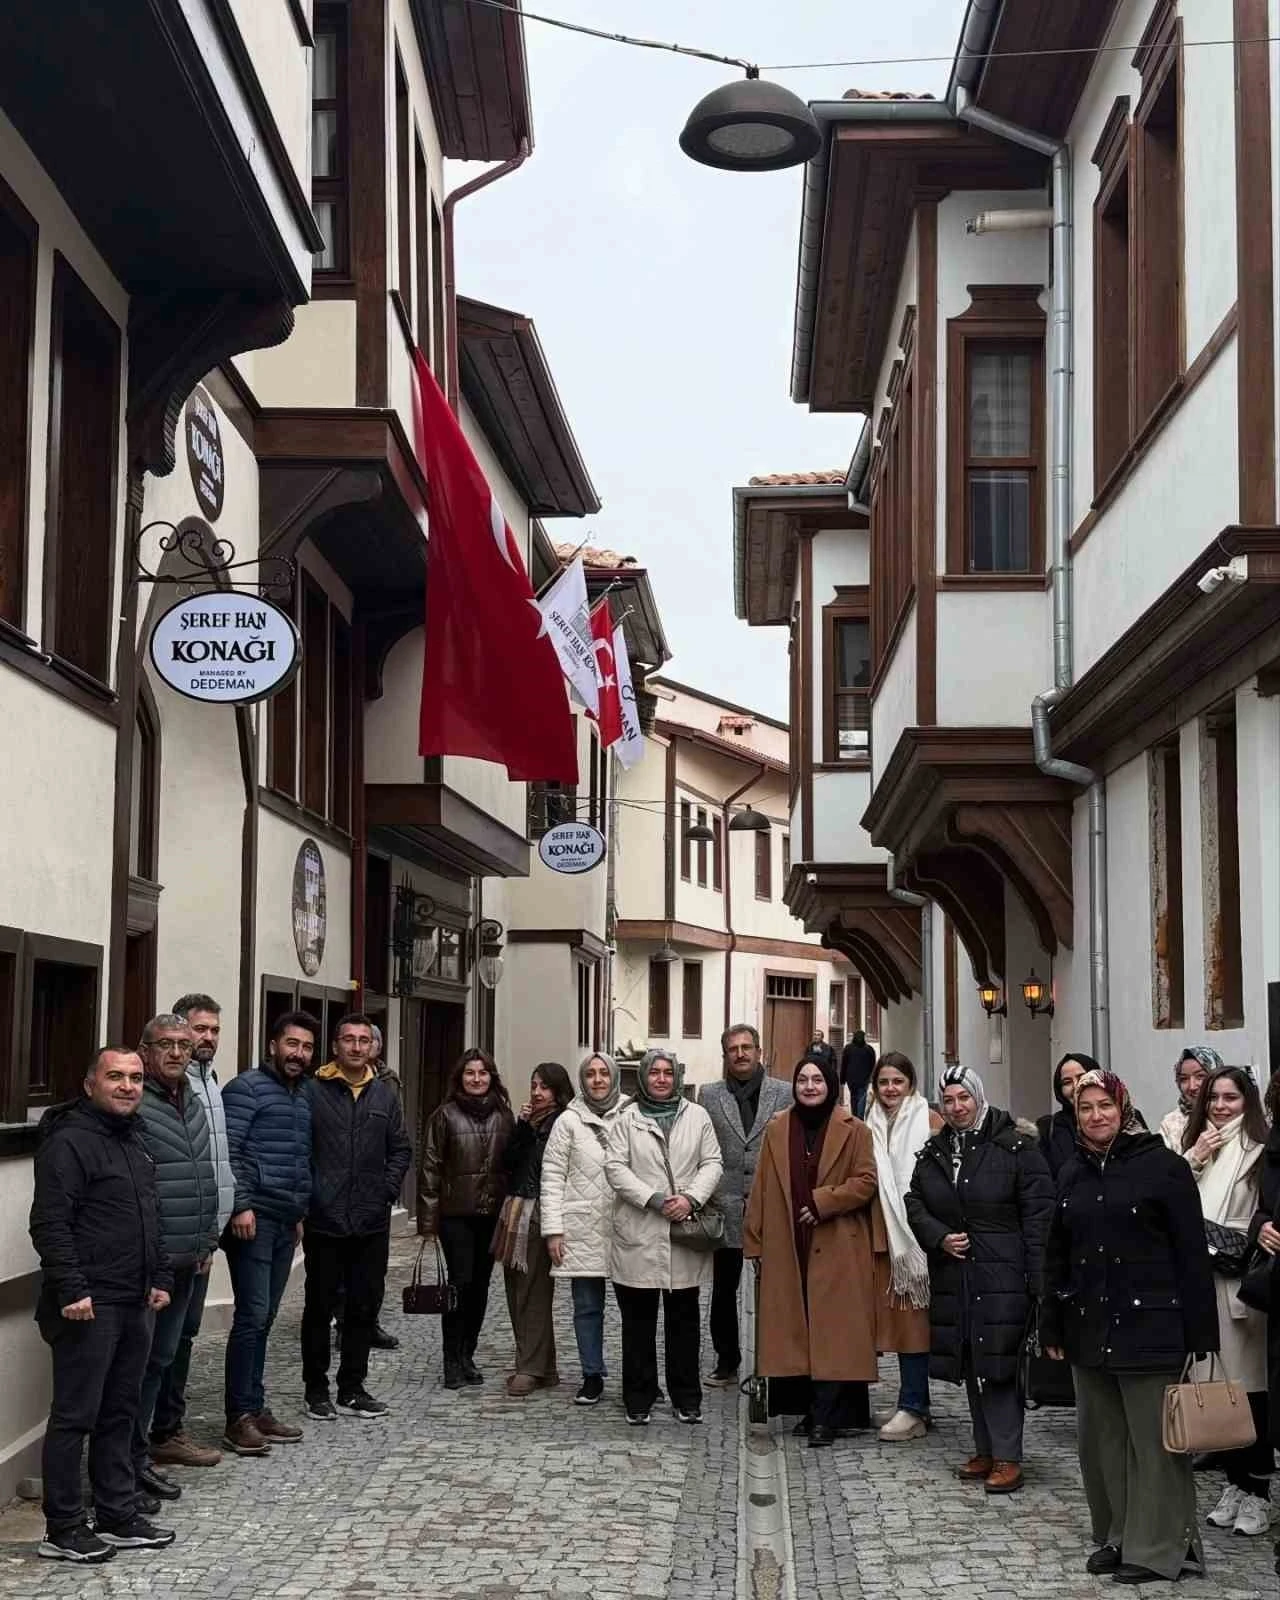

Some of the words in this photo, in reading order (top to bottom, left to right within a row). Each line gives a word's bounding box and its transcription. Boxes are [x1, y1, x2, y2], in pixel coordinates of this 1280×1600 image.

[180, 612, 231, 630] ŞEREF
[235, 612, 267, 630] HAN
[171, 635, 276, 664] KONAĞI
[190, 678, 256, 690] DEDEMAN
